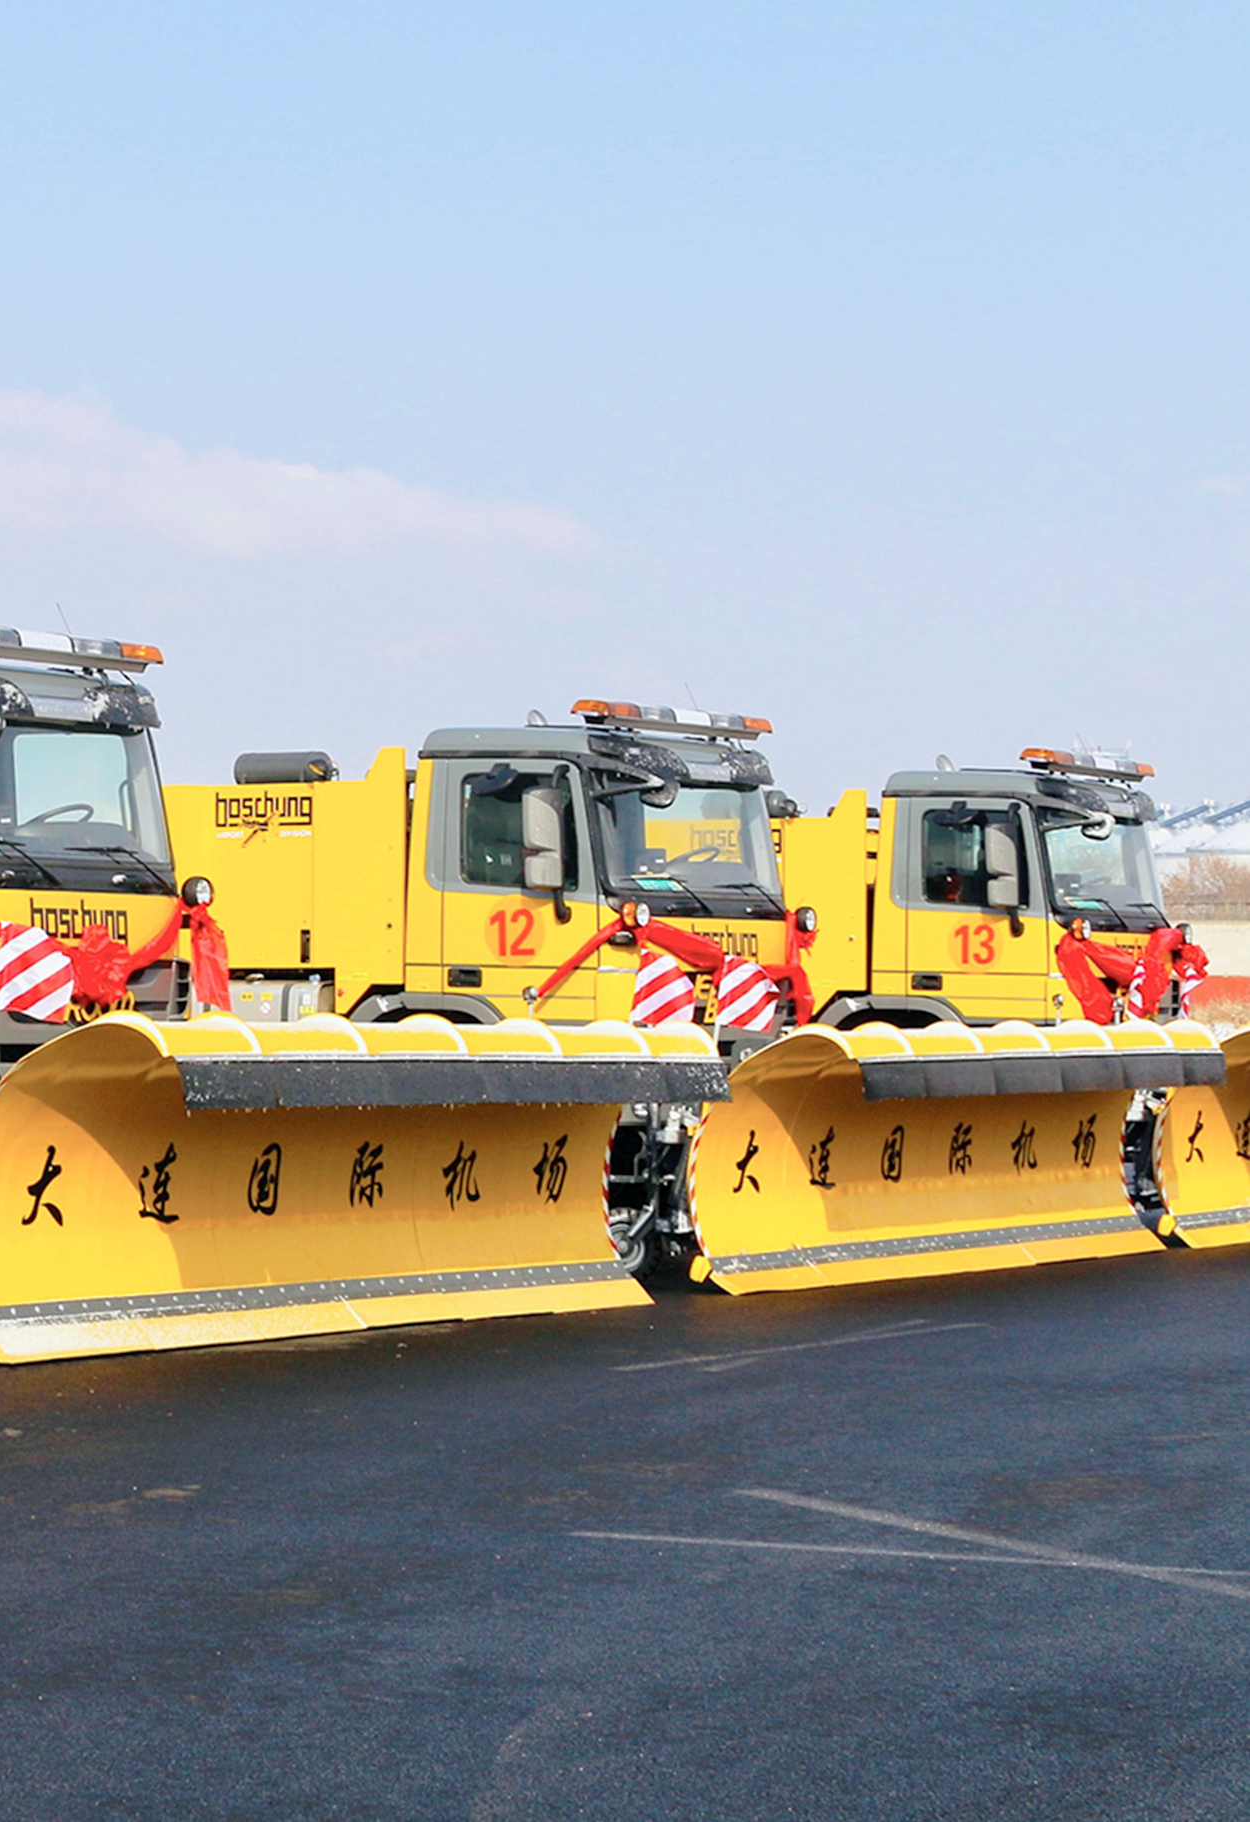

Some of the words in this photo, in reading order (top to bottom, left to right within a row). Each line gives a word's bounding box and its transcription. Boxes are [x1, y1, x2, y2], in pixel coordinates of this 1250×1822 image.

[215, 790, 312, 828] boschung
[489, 908, 536, 957] 12
[954, 924, 996, 965] 13
[732, 1113, 1098, 1193] 大连国际机场
[21, 1133, 569, 1226] 大连国际机场
